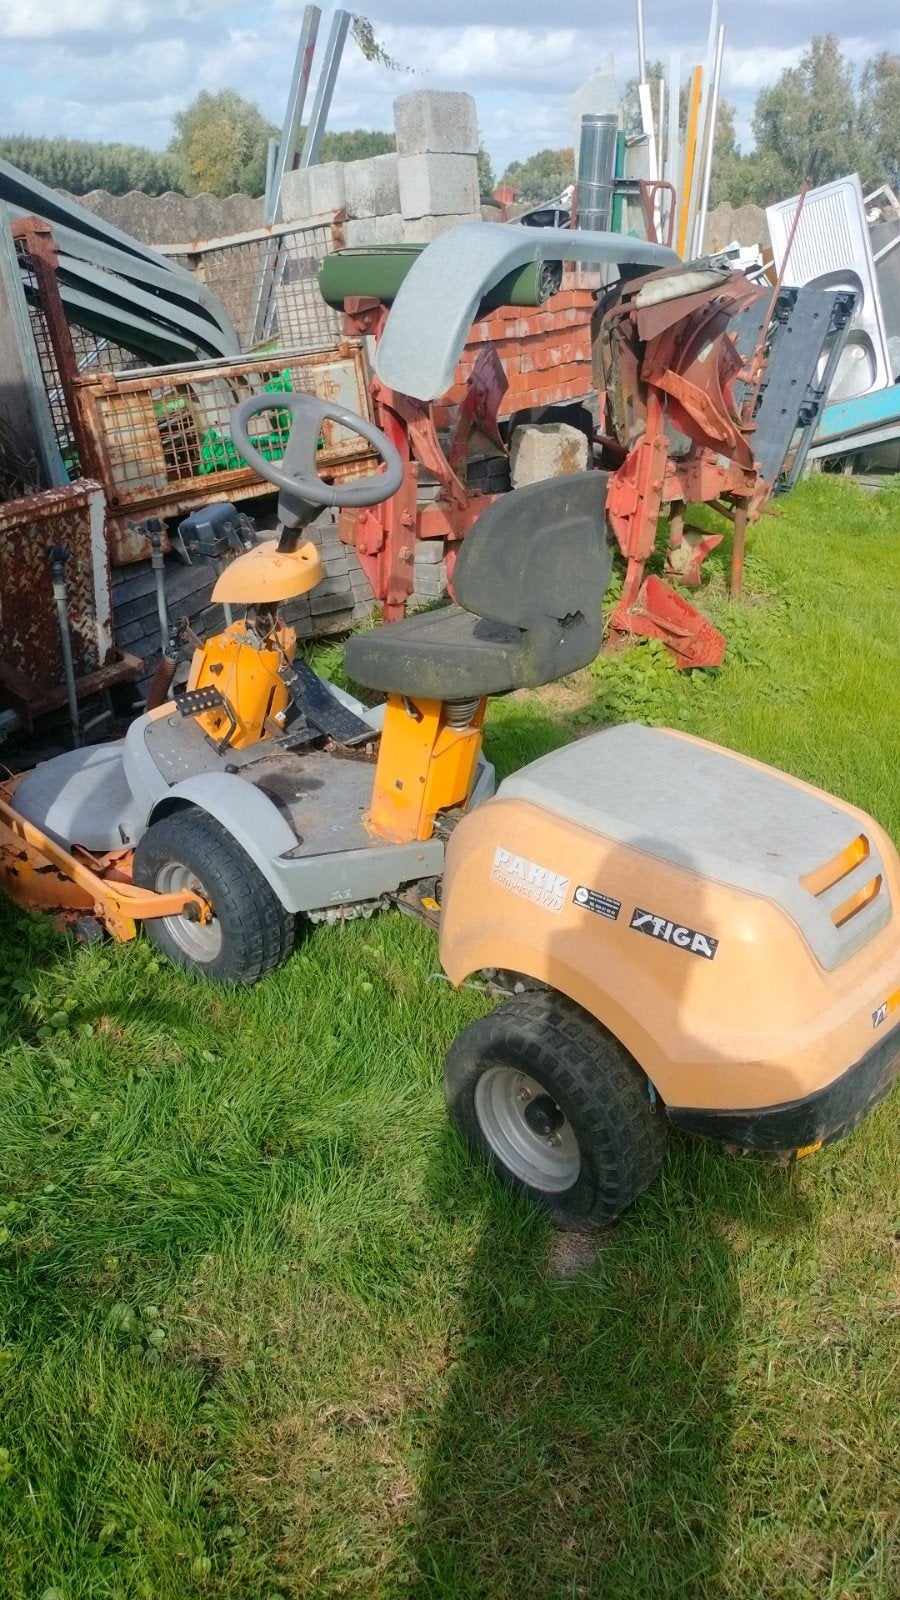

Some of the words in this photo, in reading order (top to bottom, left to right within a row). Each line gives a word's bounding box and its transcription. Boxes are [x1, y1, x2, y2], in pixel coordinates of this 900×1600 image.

[492, 869, 533, 897] Compact
[495, 851, 569, 898] PARK
[632, 914, 712, 957] STIGA
